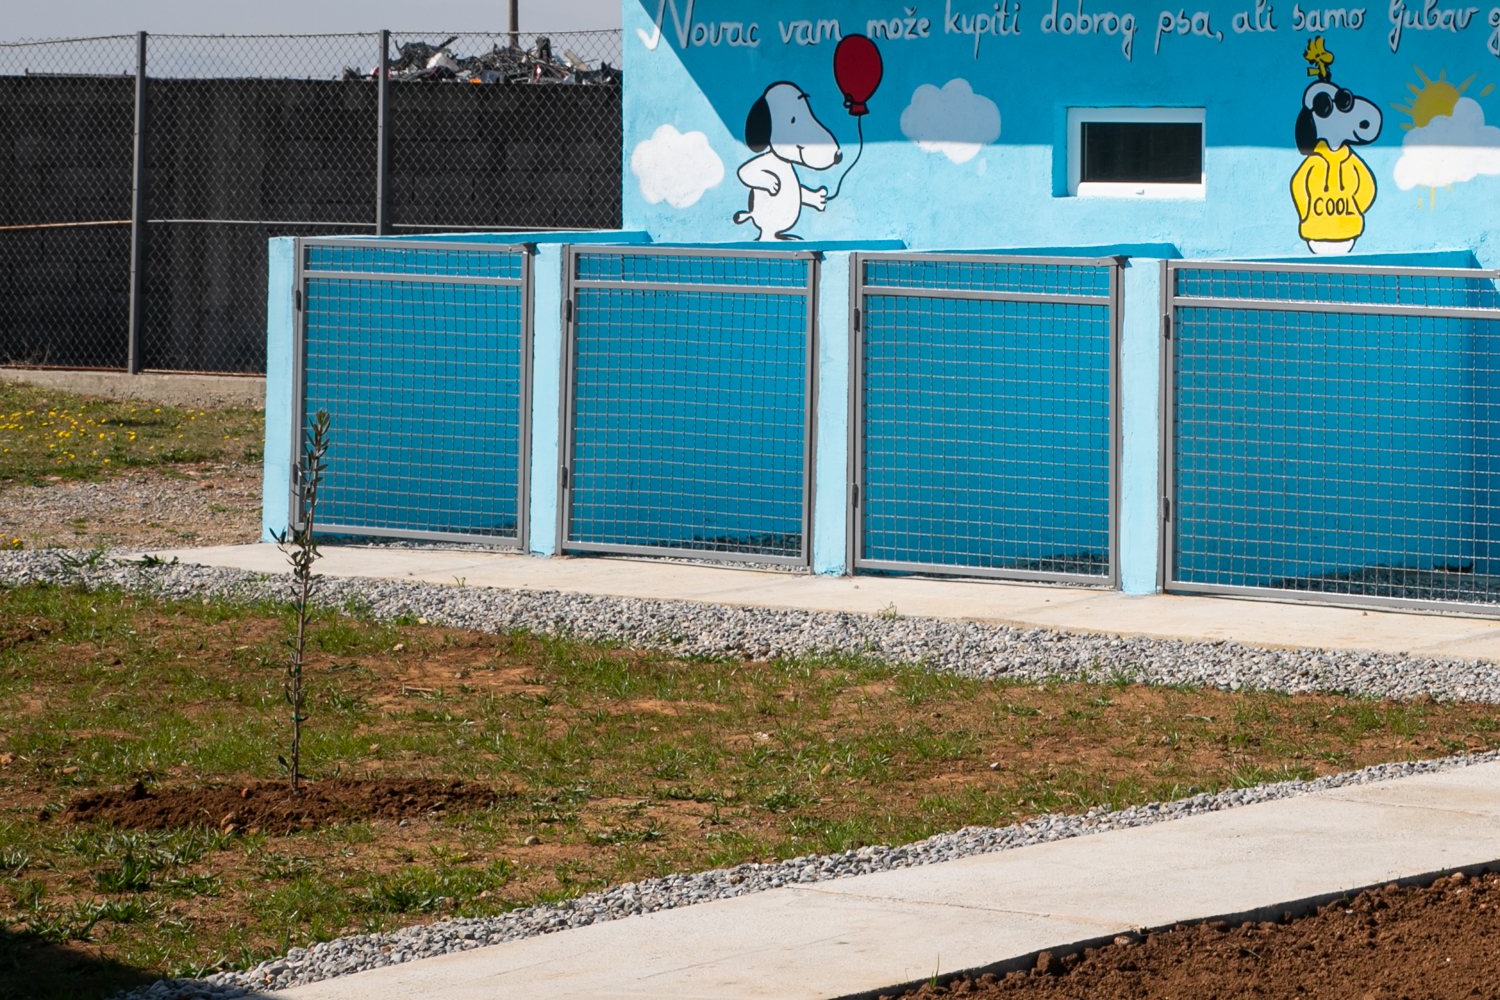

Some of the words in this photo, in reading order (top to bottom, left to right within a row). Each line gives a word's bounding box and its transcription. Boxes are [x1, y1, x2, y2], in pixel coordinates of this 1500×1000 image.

[779, 18, 843, 45] vam
[866, 6, 931, 40] može
[1155, 8, 1223, 55] psa,
[1292, 3, 1367, 34] samo
[1314, 197, 1355, 216] COOL
